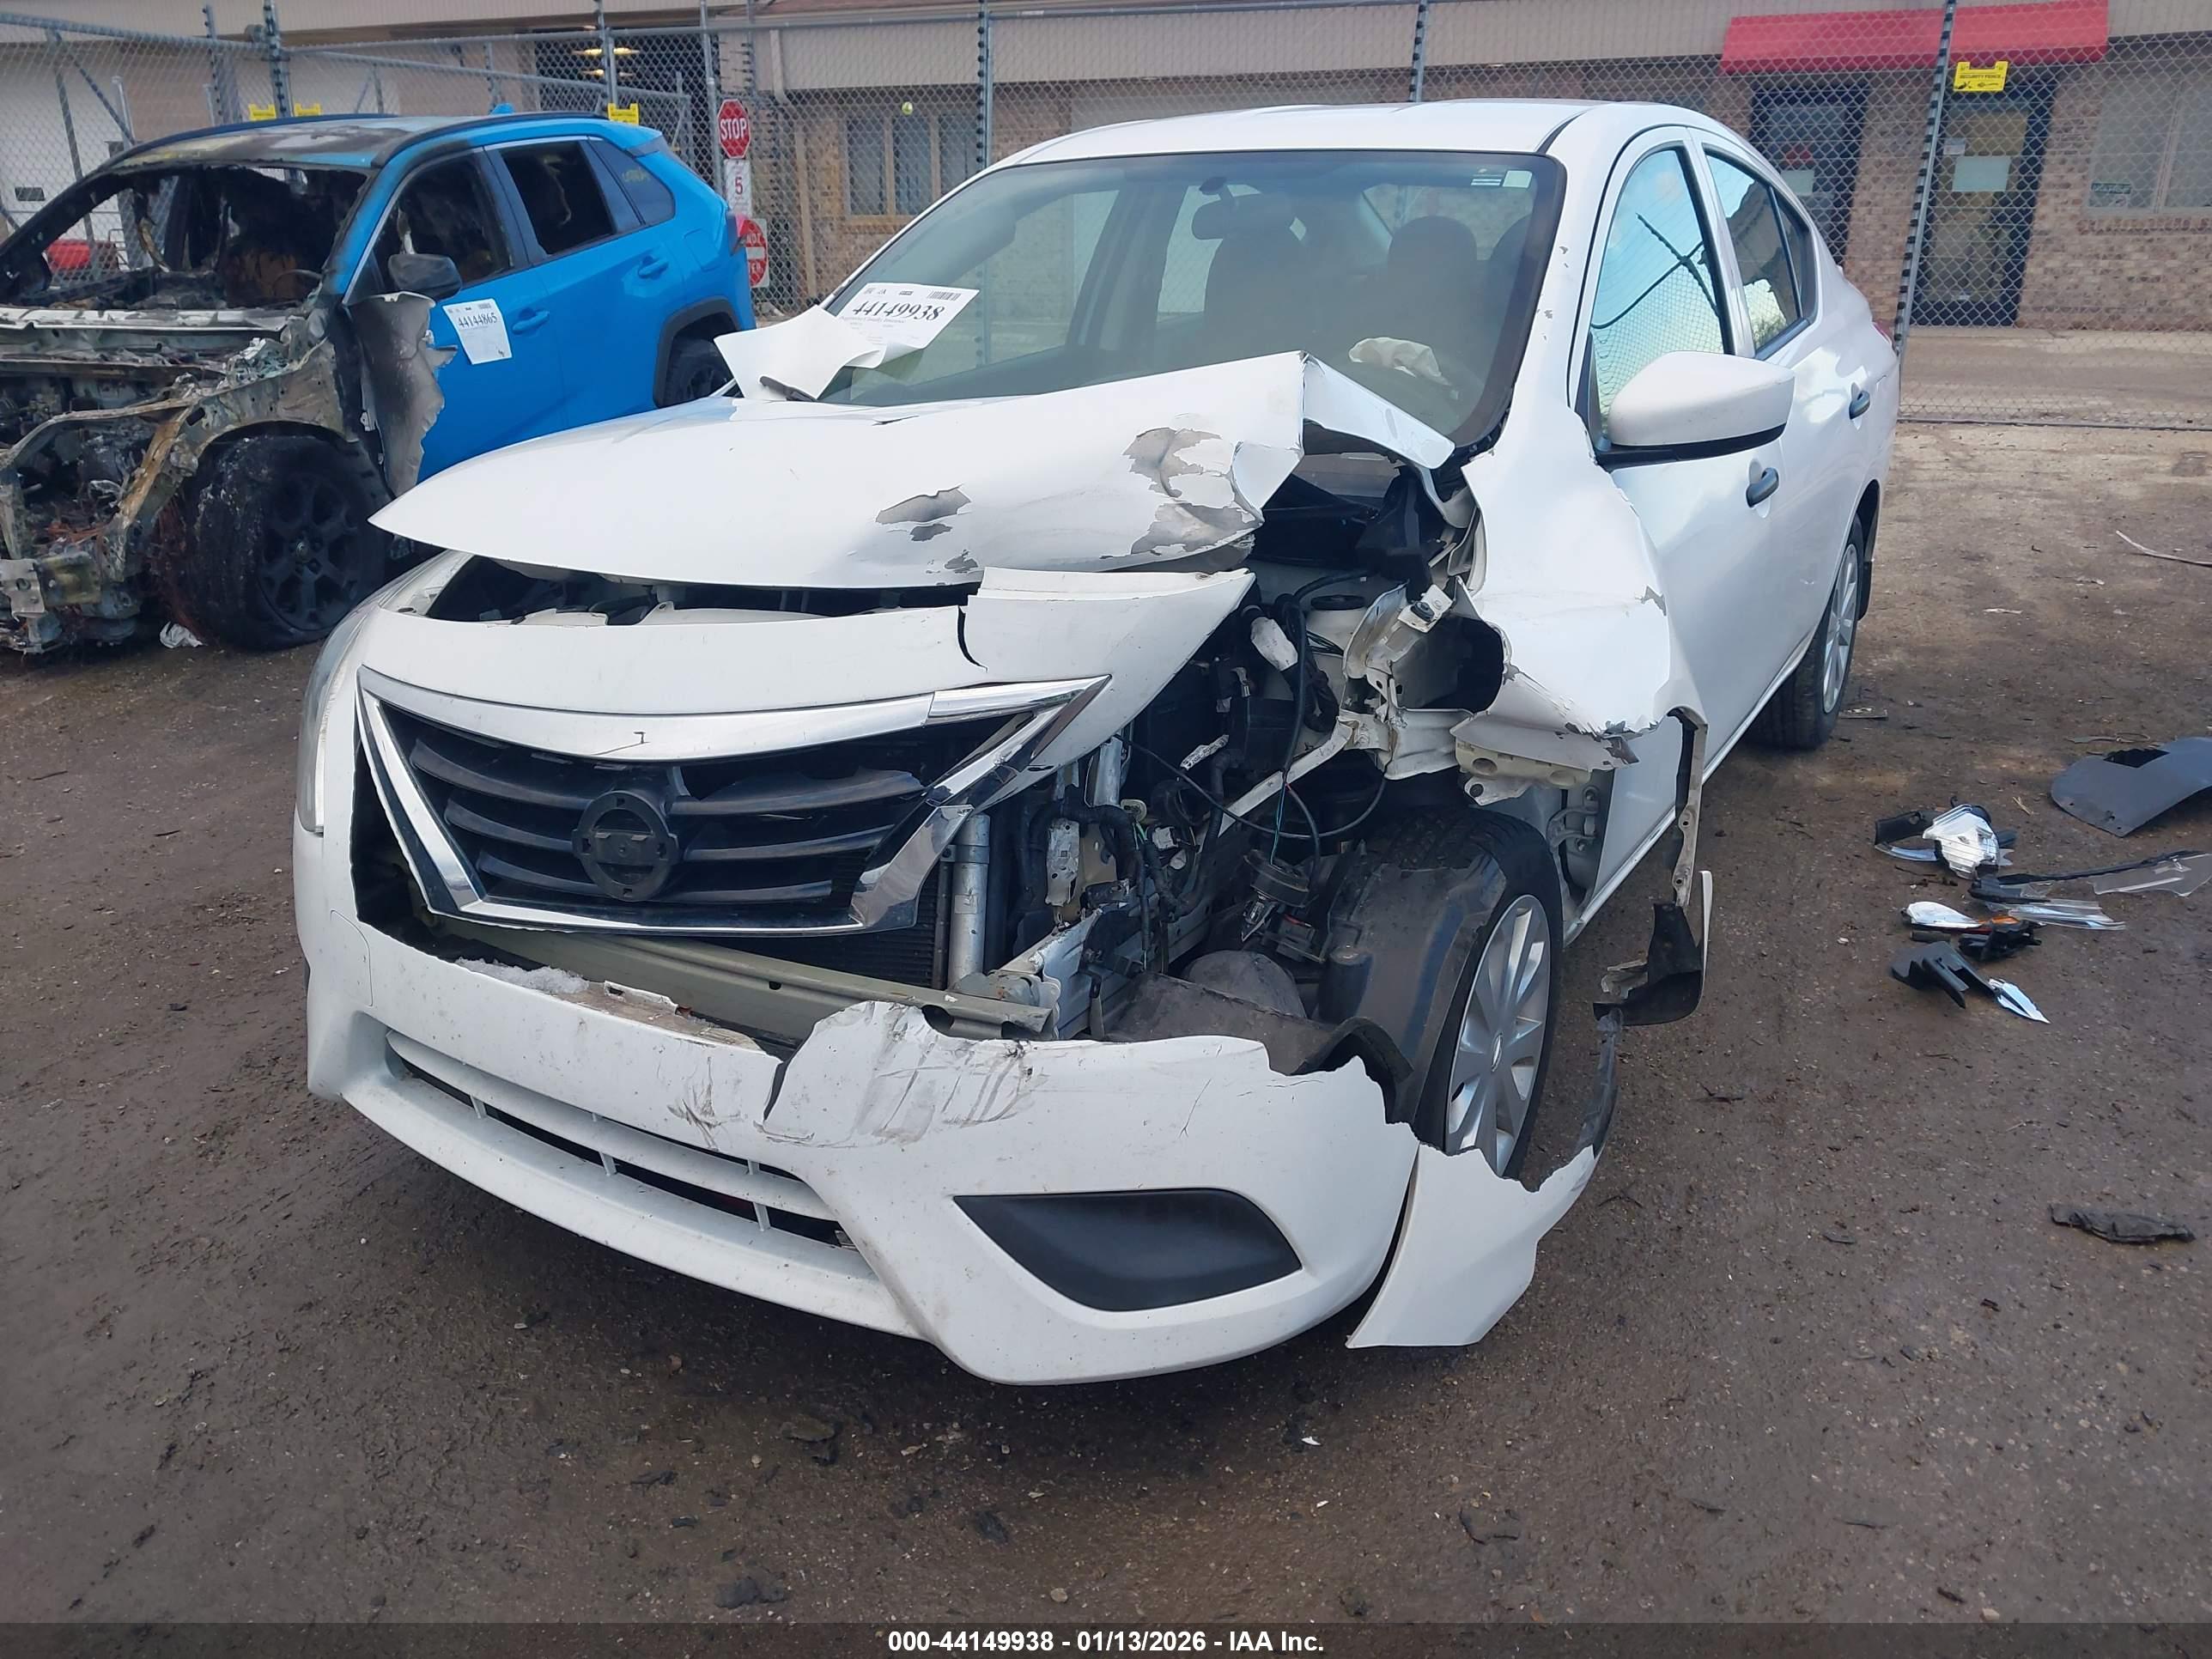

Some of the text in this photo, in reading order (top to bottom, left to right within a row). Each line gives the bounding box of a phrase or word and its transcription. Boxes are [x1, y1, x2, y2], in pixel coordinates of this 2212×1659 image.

[720, 118, 747, 140] STOP
[735, 177, 744, 195] 5
[457, 312, 498, 327] 44144865
[852, 301, 945, 321] 44149938
